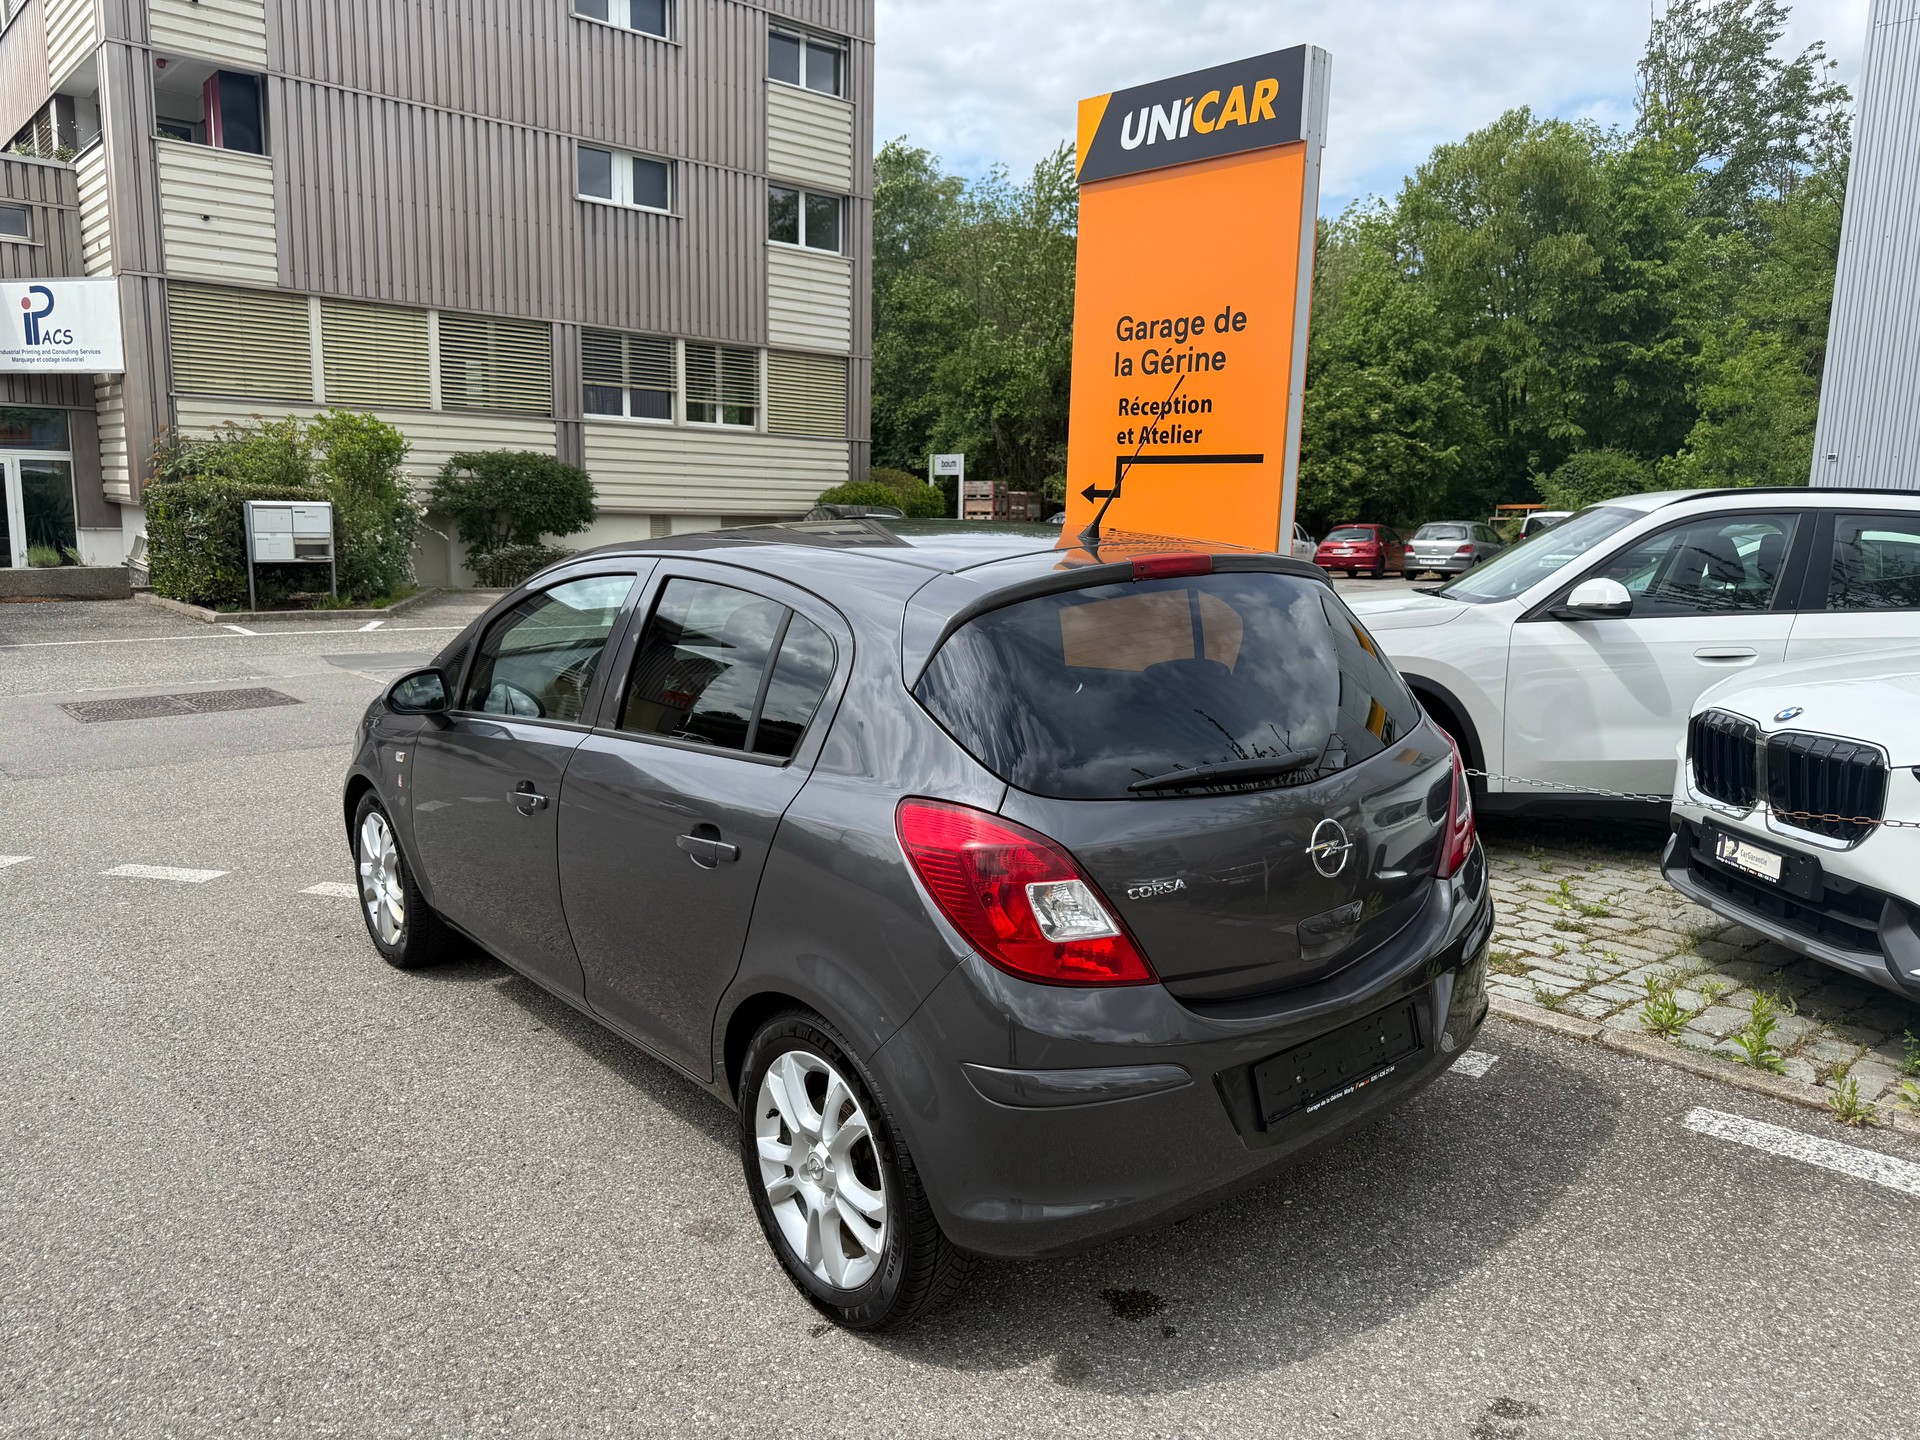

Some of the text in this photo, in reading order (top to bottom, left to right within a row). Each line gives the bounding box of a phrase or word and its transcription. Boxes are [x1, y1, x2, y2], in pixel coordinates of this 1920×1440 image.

[1116, 305, 1247, 344] Garage de
[21, 348, 41, 356] Printing
[52, 348, 79, 356] Consulting
[1114, 346, 1227, 377] la Gérine
[1118, 394, 1212, 420] Réception
[1116, 424, 1203, 445] et Atelier
[1127, 878, 1187, 900] CORSA
[1306, 1102, 1320, 1113] Garage
